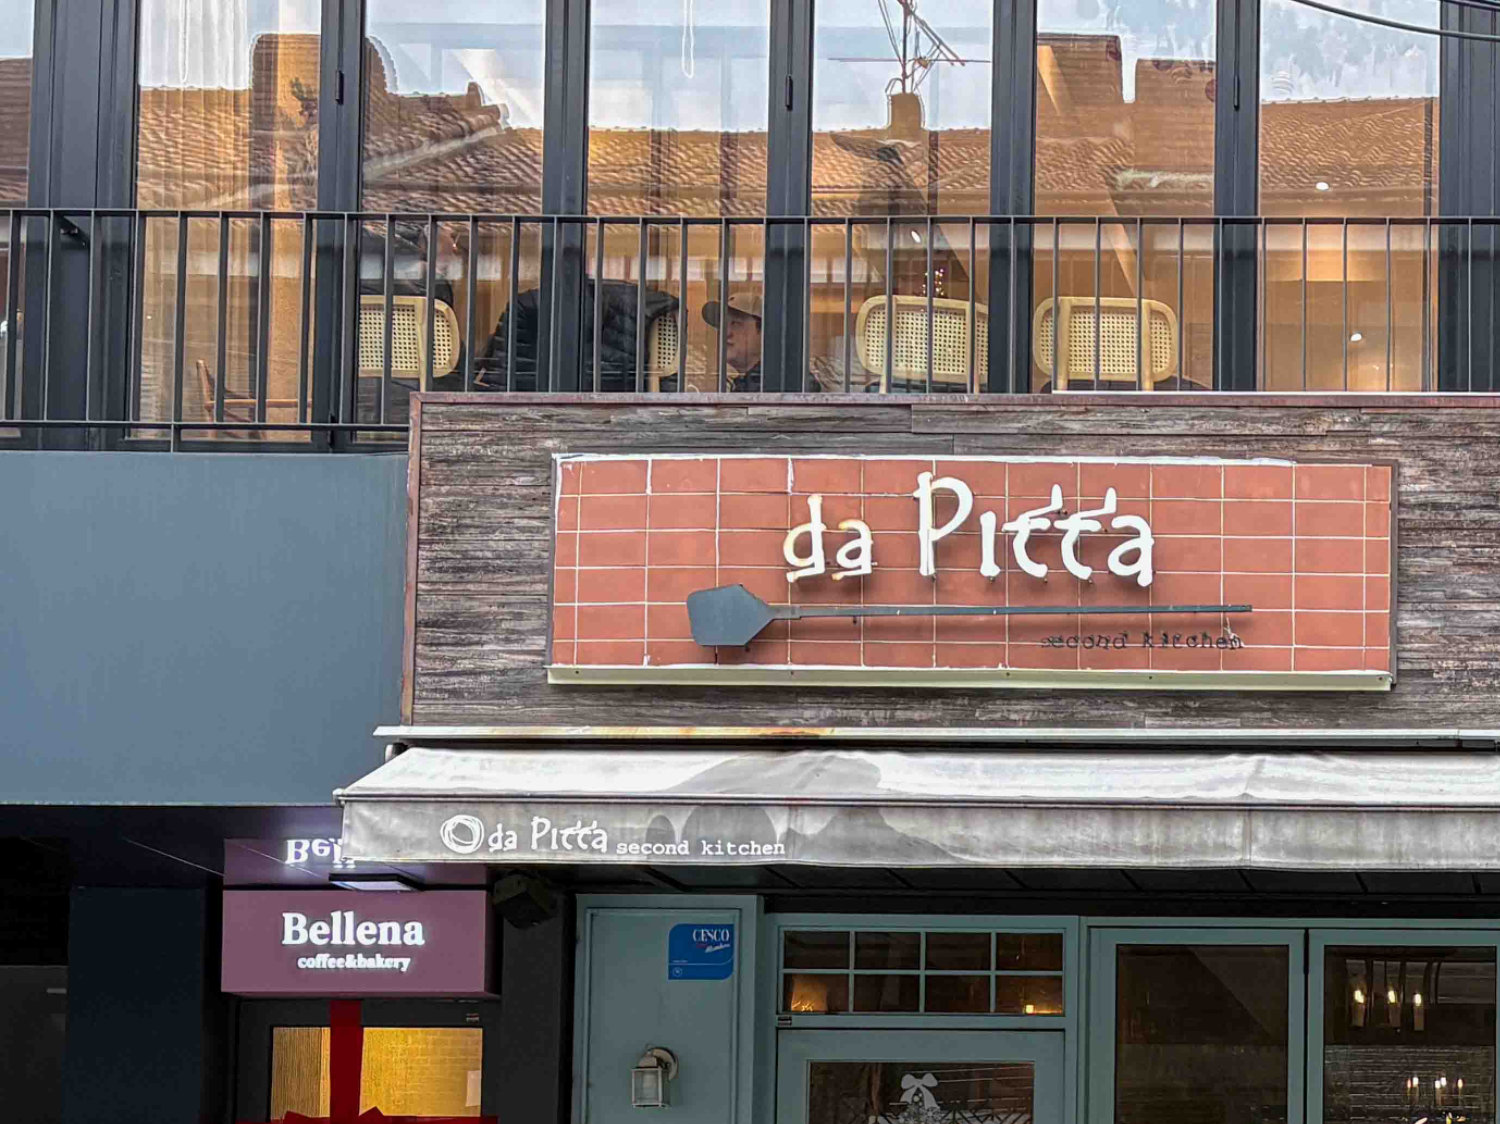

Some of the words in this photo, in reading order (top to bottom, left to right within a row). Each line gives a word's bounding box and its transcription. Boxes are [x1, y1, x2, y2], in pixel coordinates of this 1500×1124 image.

[783, 494, 873, 583] da
[913, 472, 1154, 586] Pitta
[1040, 632, 1129, 650] second
[1142, 632, 1245, 650] kitchen
[487, 824, 517, 852] da
[531, 816, 608, 854] Pitta
[616, 841, 690, 856] second
[701, 841, 785, 856] kitchen
[281, 910, 425, 945] Bellena
[692, 929, 730, 941] CESCO
[297, 953, 411, 972] coffee&bakery
